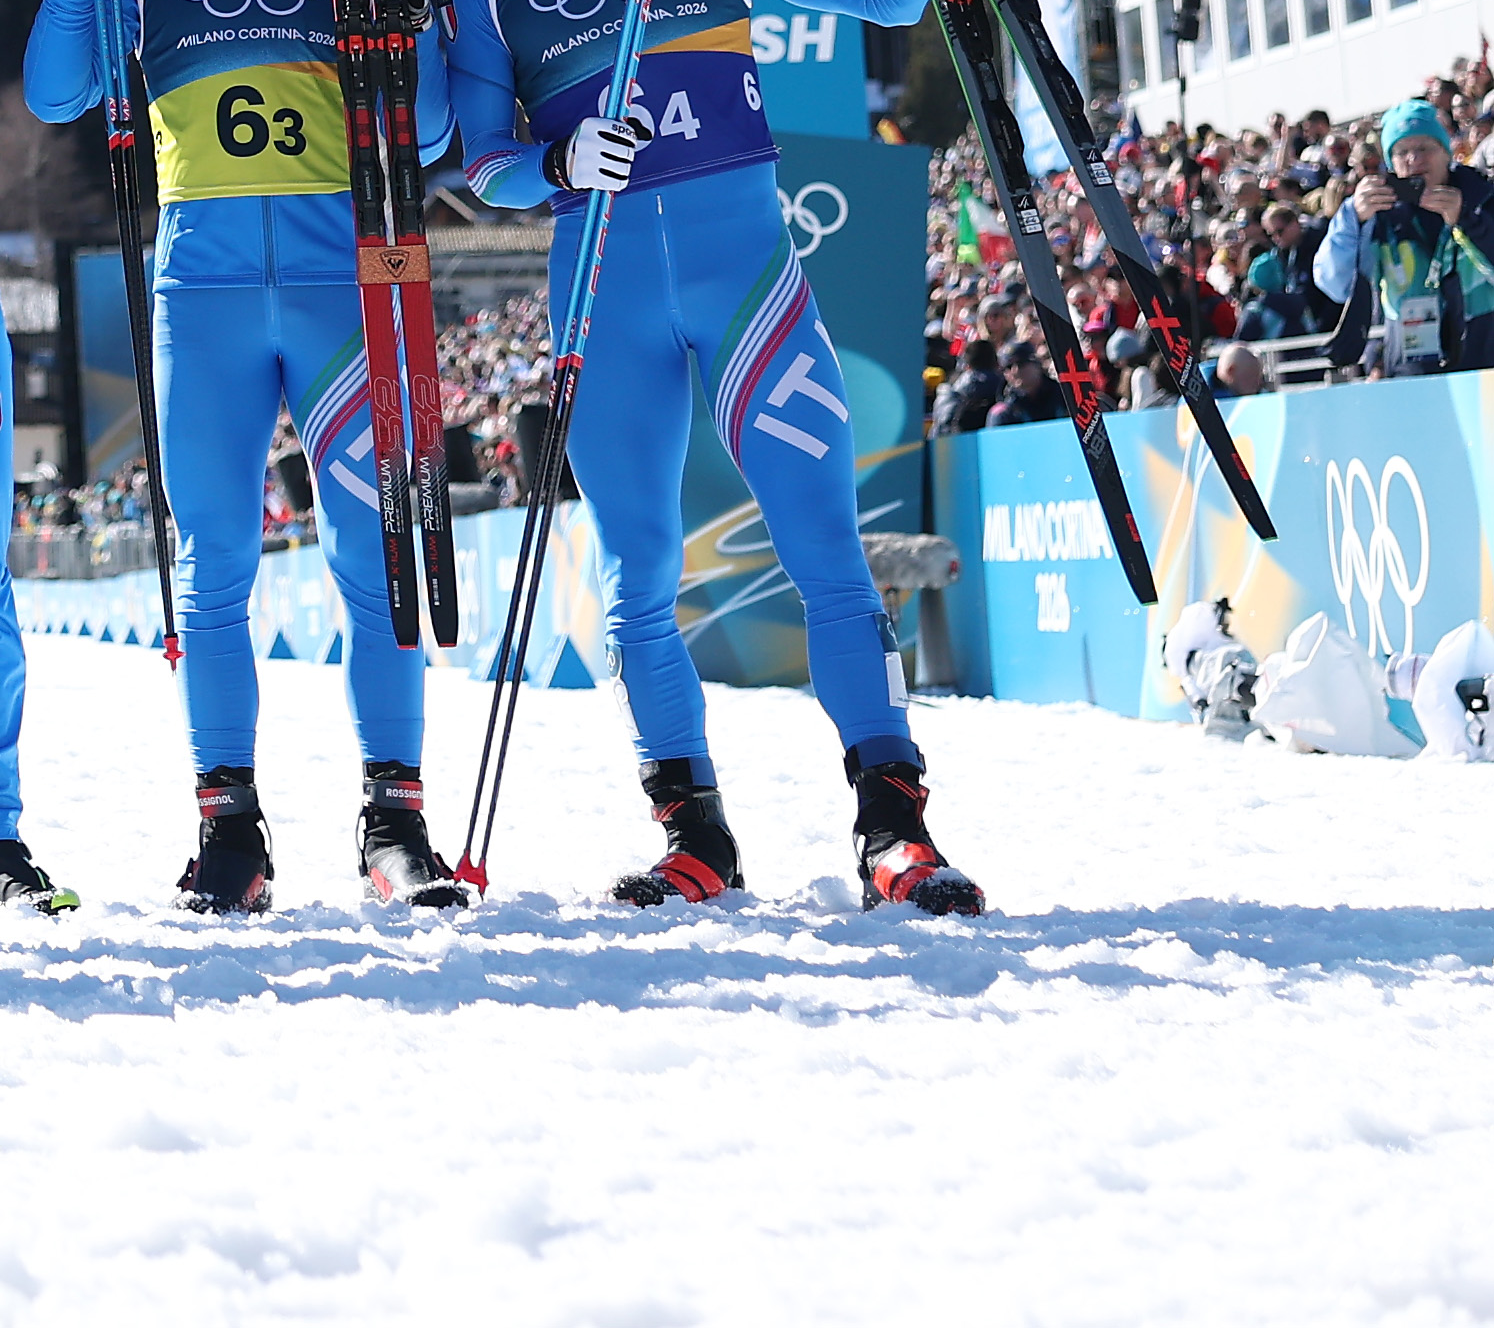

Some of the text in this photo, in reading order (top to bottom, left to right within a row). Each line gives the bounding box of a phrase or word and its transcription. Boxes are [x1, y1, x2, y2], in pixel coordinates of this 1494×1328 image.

[176, 27, 336, 49] MILANO CORTINA 2026
[540, 2, 708, 64] MILANO CONA 2026
[751, 13, 837, 64] SH
